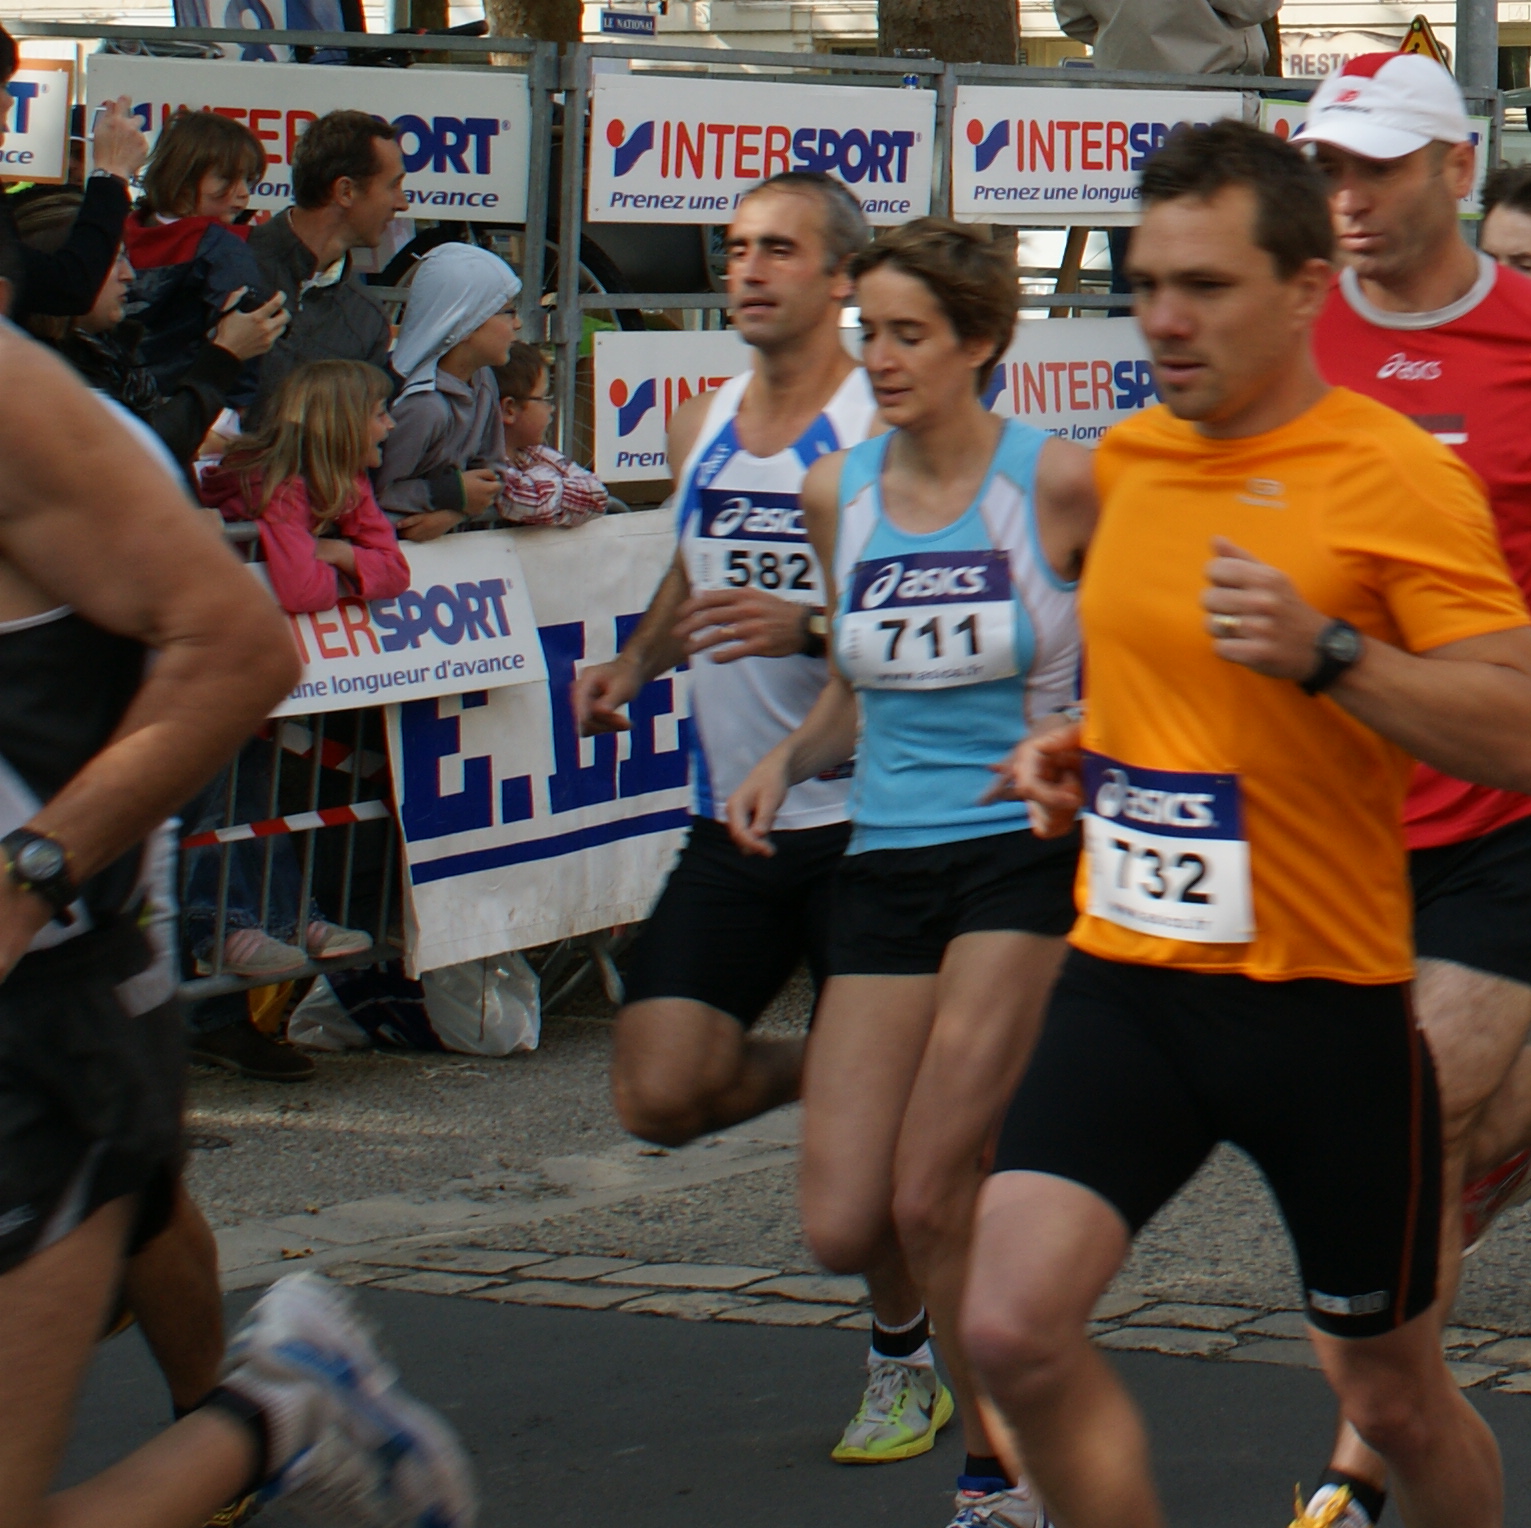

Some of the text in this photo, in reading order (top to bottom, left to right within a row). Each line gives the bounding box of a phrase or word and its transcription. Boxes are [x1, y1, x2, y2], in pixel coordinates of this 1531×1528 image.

[660, 120, 915, 184] INTERSPORT
[609, 191, 685, 210] Prenez
[688, 194, 729, 210] une
[974, 184, 1141, 203] Prenez une longue
[616, 451, 670, 468] Pren
[727, 549, 814, 590] 582
[896, 565, 989, 599] asics
[876, 612, 982, 663] 711
[332, 665, 430, 694] longueur
[435, 653, 525, 680] d'avance
[1111, 837, 1214, 906] 732
